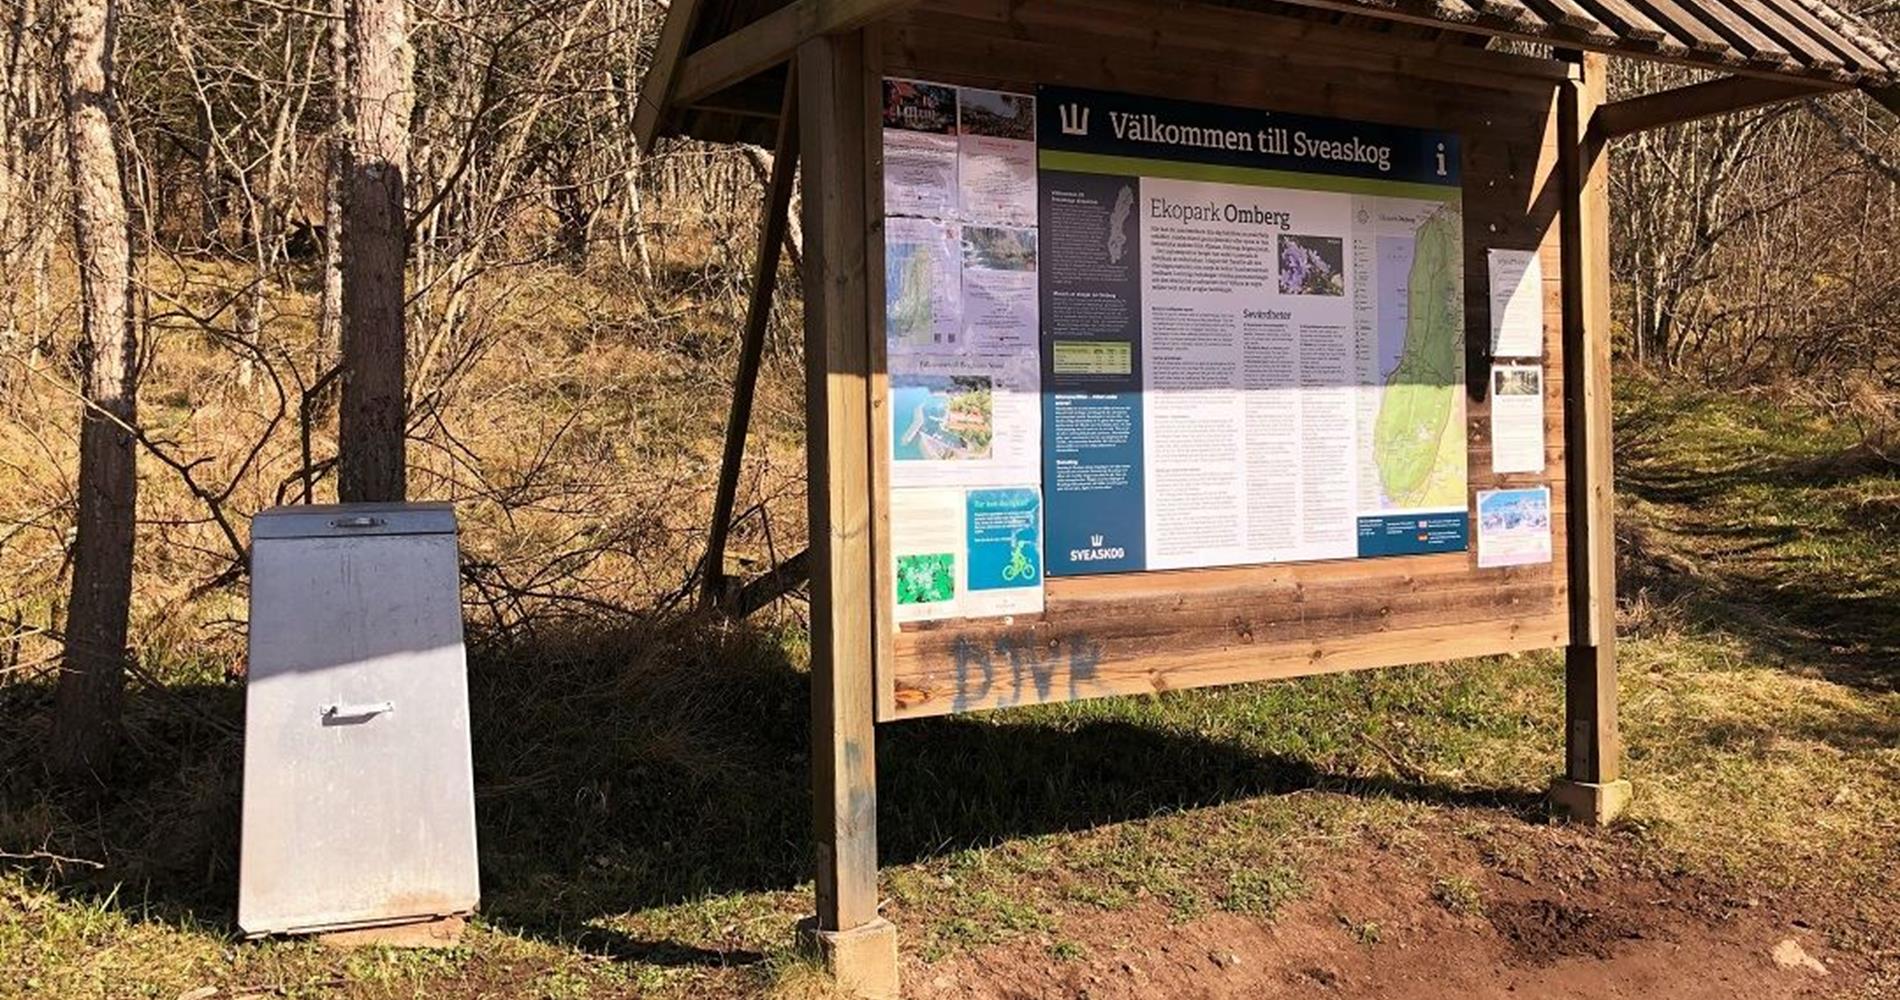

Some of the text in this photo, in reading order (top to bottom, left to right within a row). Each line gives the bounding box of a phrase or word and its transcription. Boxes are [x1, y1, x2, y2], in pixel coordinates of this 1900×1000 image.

[1109, 111, 1391, 170] Välkommen till Sveaskog
[1150, 198, 1290, 230] Ekopark Omberg
[1069, 546, 1125, 562] SVEASKOG
